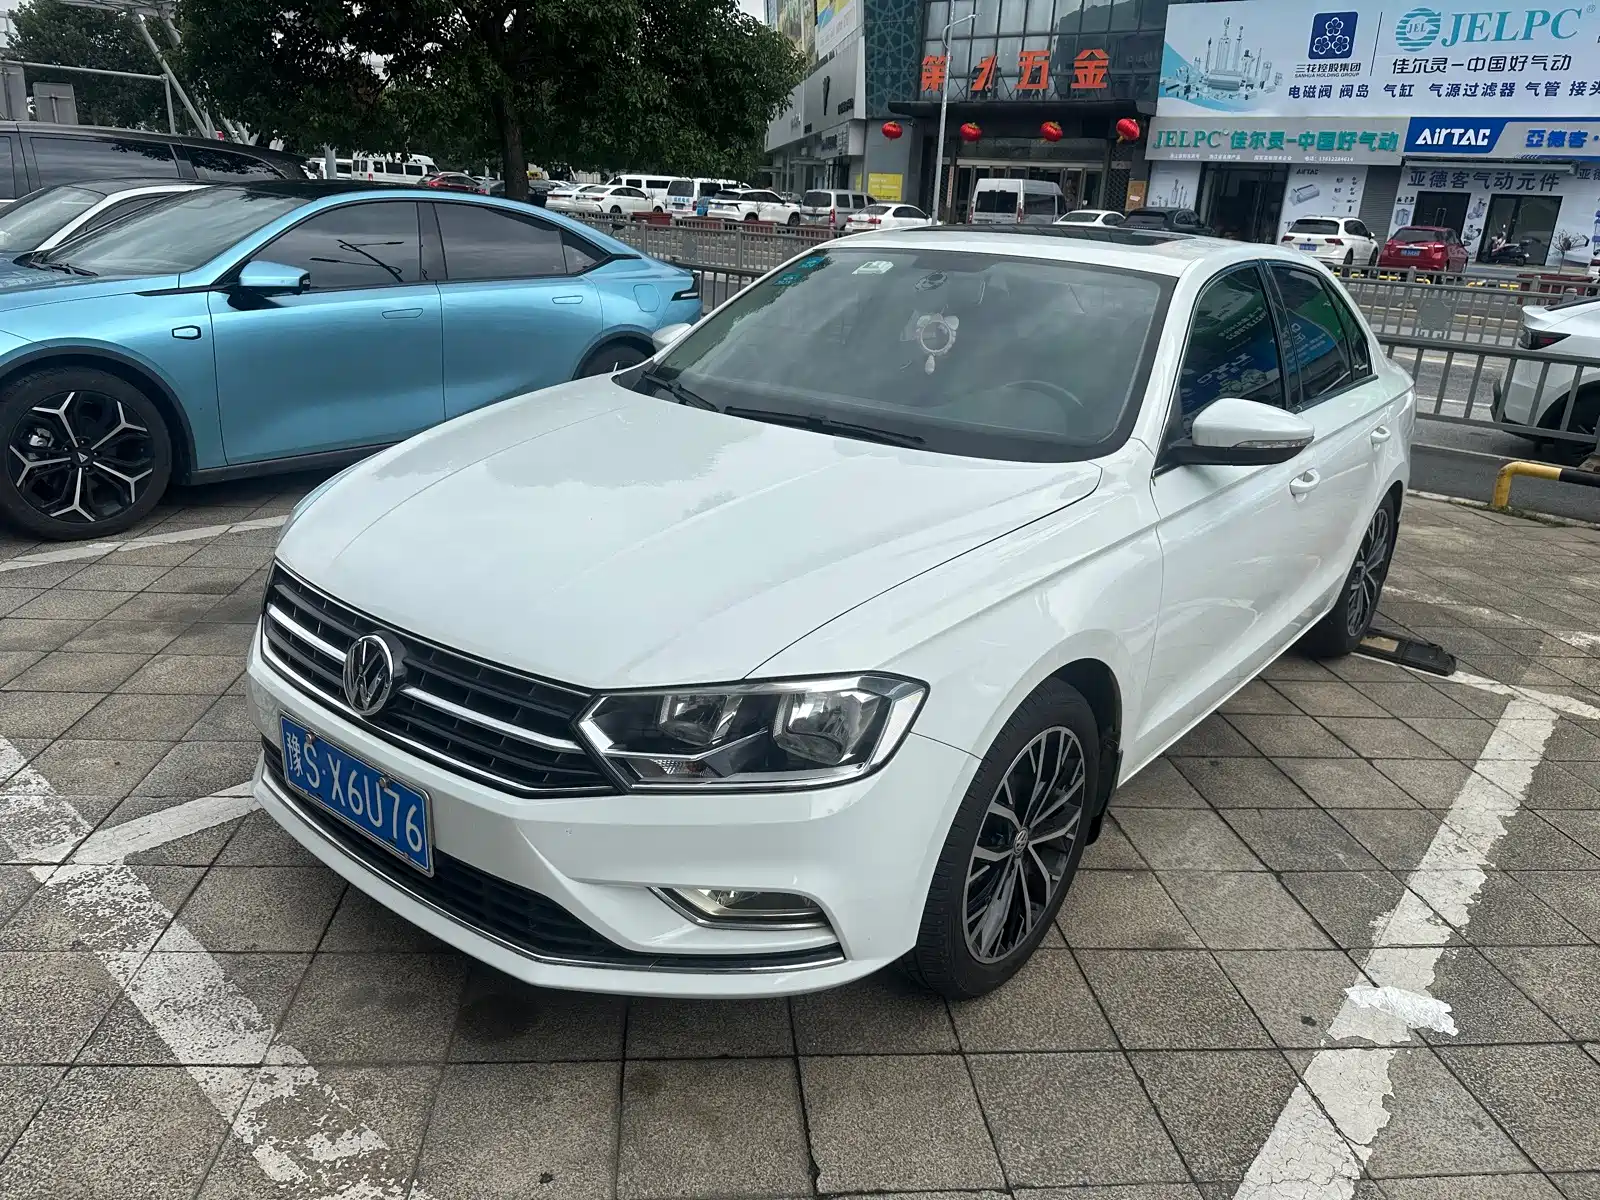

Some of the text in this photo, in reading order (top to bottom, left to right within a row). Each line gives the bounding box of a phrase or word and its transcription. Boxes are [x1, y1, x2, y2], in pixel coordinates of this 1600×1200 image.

[1406, 23, 1427, 34] JEL
[1441, 8, 1582, 47] JELPC
[1296, 62, 1361, 73] 三花控股集团
[1288, 84, 1333, 99] 电磁阀
[1339, 83, 1370, 98] 阀岛
[1383, 83, 1415, 98] 气缸
[1428, 82, 1516, 97] 气源过滤器
[1524, 80, 1562, 97] 气管
[1153, 130, 1221, 149] JELPC
[1407, 169, 1560, 192] 亚德客气动元件
